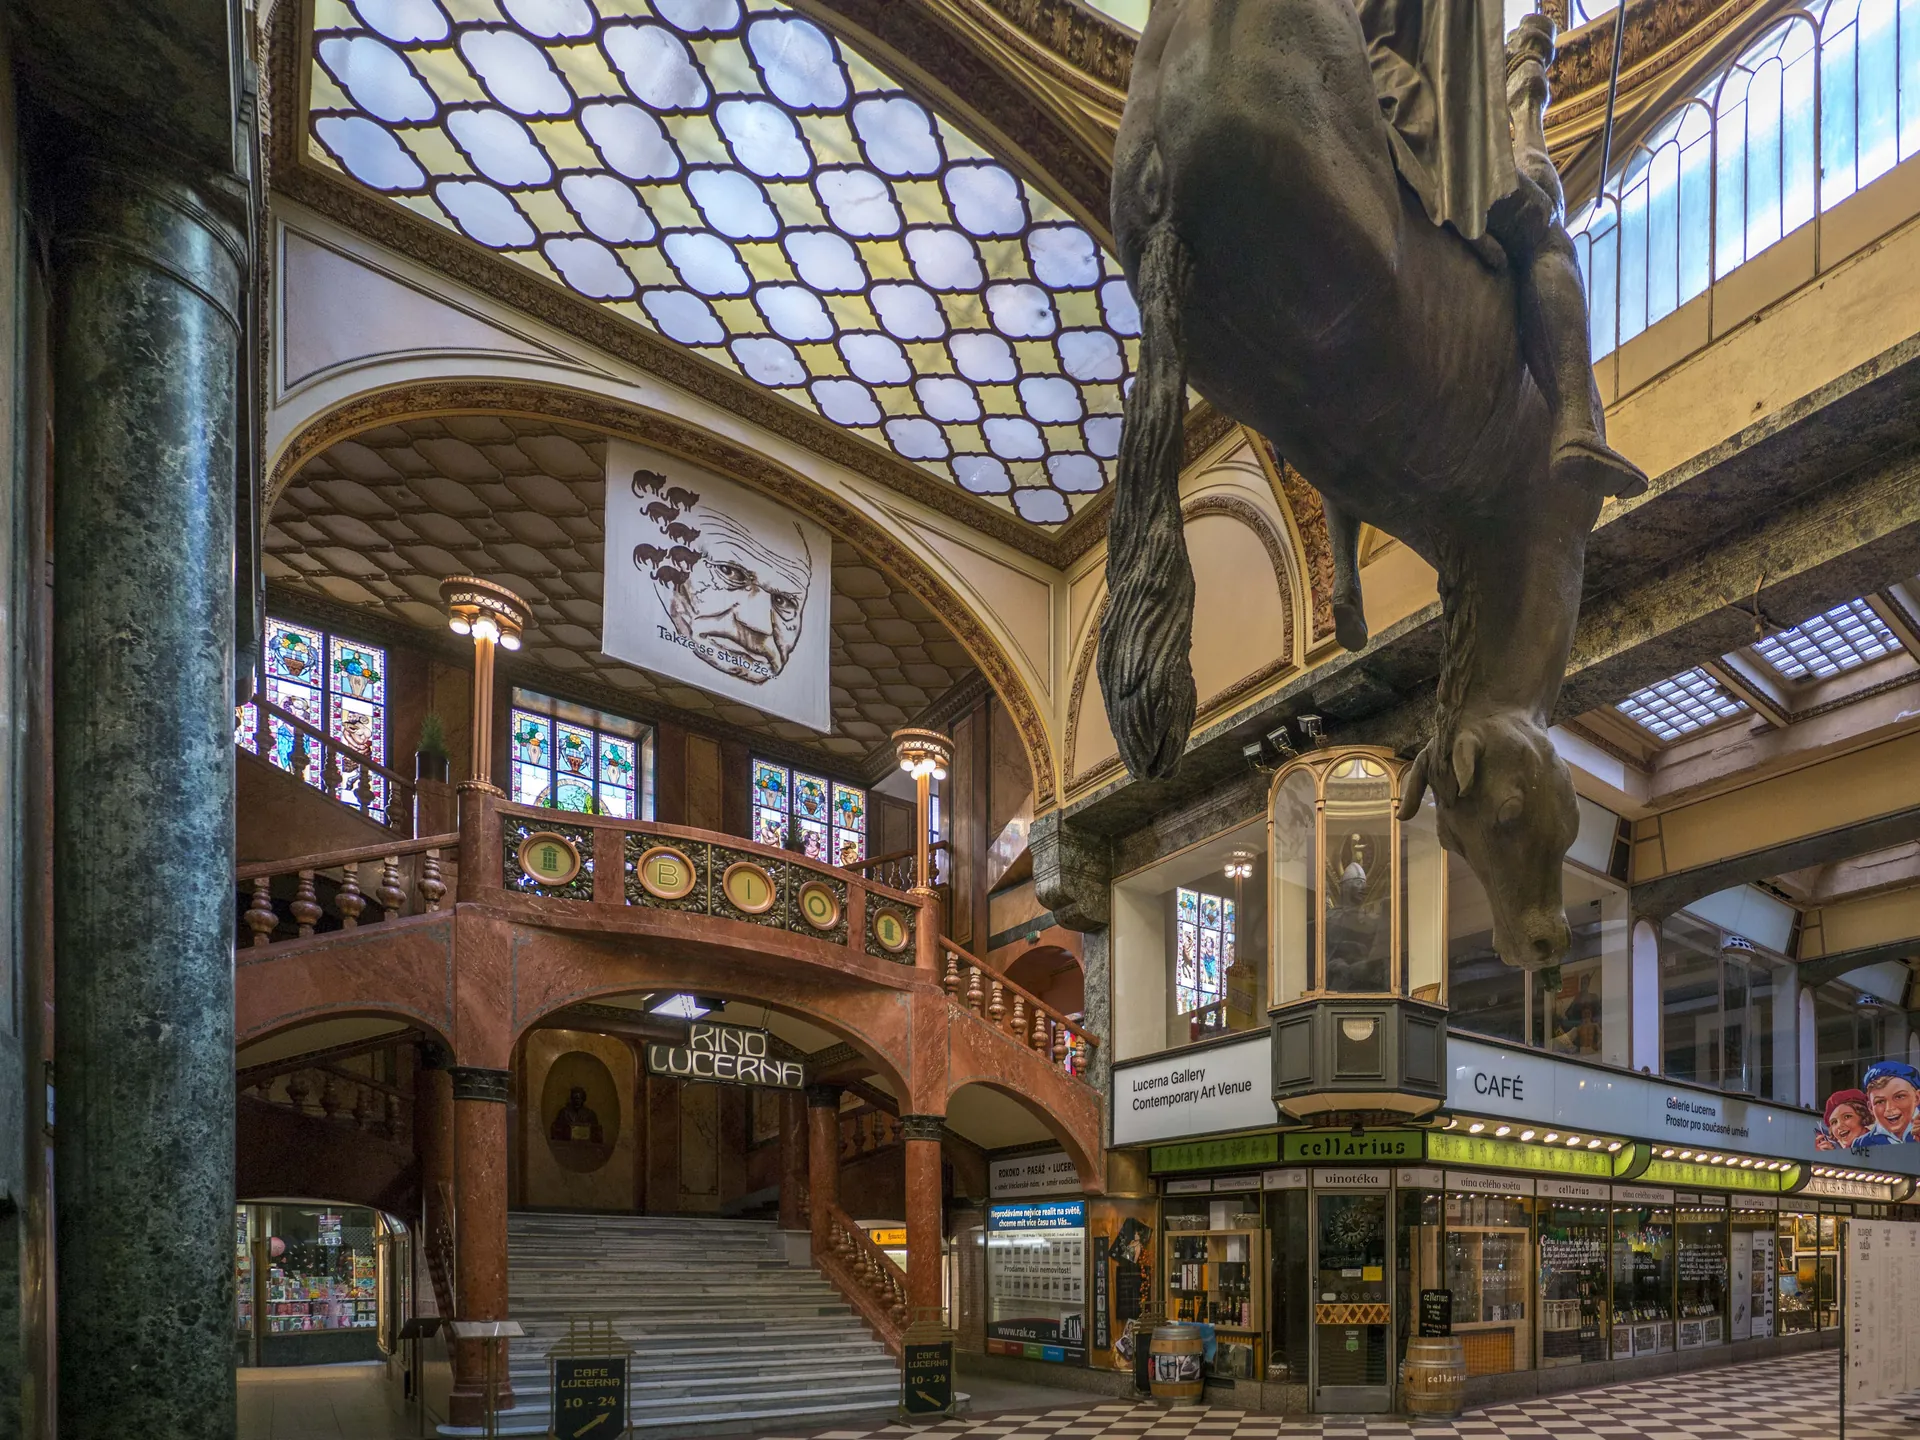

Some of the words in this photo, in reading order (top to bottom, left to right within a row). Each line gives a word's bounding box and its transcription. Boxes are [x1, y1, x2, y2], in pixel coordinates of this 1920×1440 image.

[656, 625, 696, 650] Takže
[699, 643, 714, 656] se
[690, 1024, 766, 1057] KINO
[651, 1046, 803, 1086] LUCERNA
[1132, 1075, 1169, 1093] Lucerna
[1171, 1068, 1206, 1085] Gallery
[1474, 1072, 1524, 1101] CAFÉ
[1132, 1089, 1199, 1111] Contemporary
[1200, 1085, 1216, 1099] Art
[1218, 1080, 1252, 1096] Venue
[1666, 1097, 1690, 1113] Galerie
[1690, 1102, 1716, 1117] Lucerna
[1665, 1114, 1689, 1129] Prostor
[1689, 1120, 1701, 1132] pro
[1701, 1122, 1731, 1135] současné
[1731, 1127, 1750, 1138] umění
[1299, 1137, 1405, 1157] cellarius
[998, 1167, 1020, 1178] ROKOKO
[1325, 1173, 1378, 1184] vinotéka
[1460, 1177, 1478, 1188] vína
[1478, 1179, 1501, 1190] celého
[1502, 1180, 1521, 1191] světa
[1558, 1186, 1590, 1196] cellarius
[991, 1208, 1023, 1220] Neprodáváme
[1023, 1208, 1041, 1219] nejvíce
[1042, 1206, 1056, 1216] realit
[1057, 1208, 1064, 1216] na
[998, 1219, 1016, 1227] chceme
[1017, 1218, 1026, 1227] mít
[1026, 1218, 1037, 1227] více
[1037, 1218, 1049, 1227] času
[1004, 1264, 1025, 1273] Prodáme
[1765, 1238, 1774, 1338] cellarius
[997, 1326, 1037, 1339] www.rak.cz
[916, 1351, 941, 1360] CAFE
[908, 1360, 949, 1368] LUCERNA
[573, 1368, 609, 1378] CAFE
[911, 1375, 924, 1385] 10
[933, 1374, 947, 1383] 24
[561, 1378, 621, 1388] LUCERNA
[564, 1397, 583, 1409] 10
[597, 1395, 617, 1408] 24
